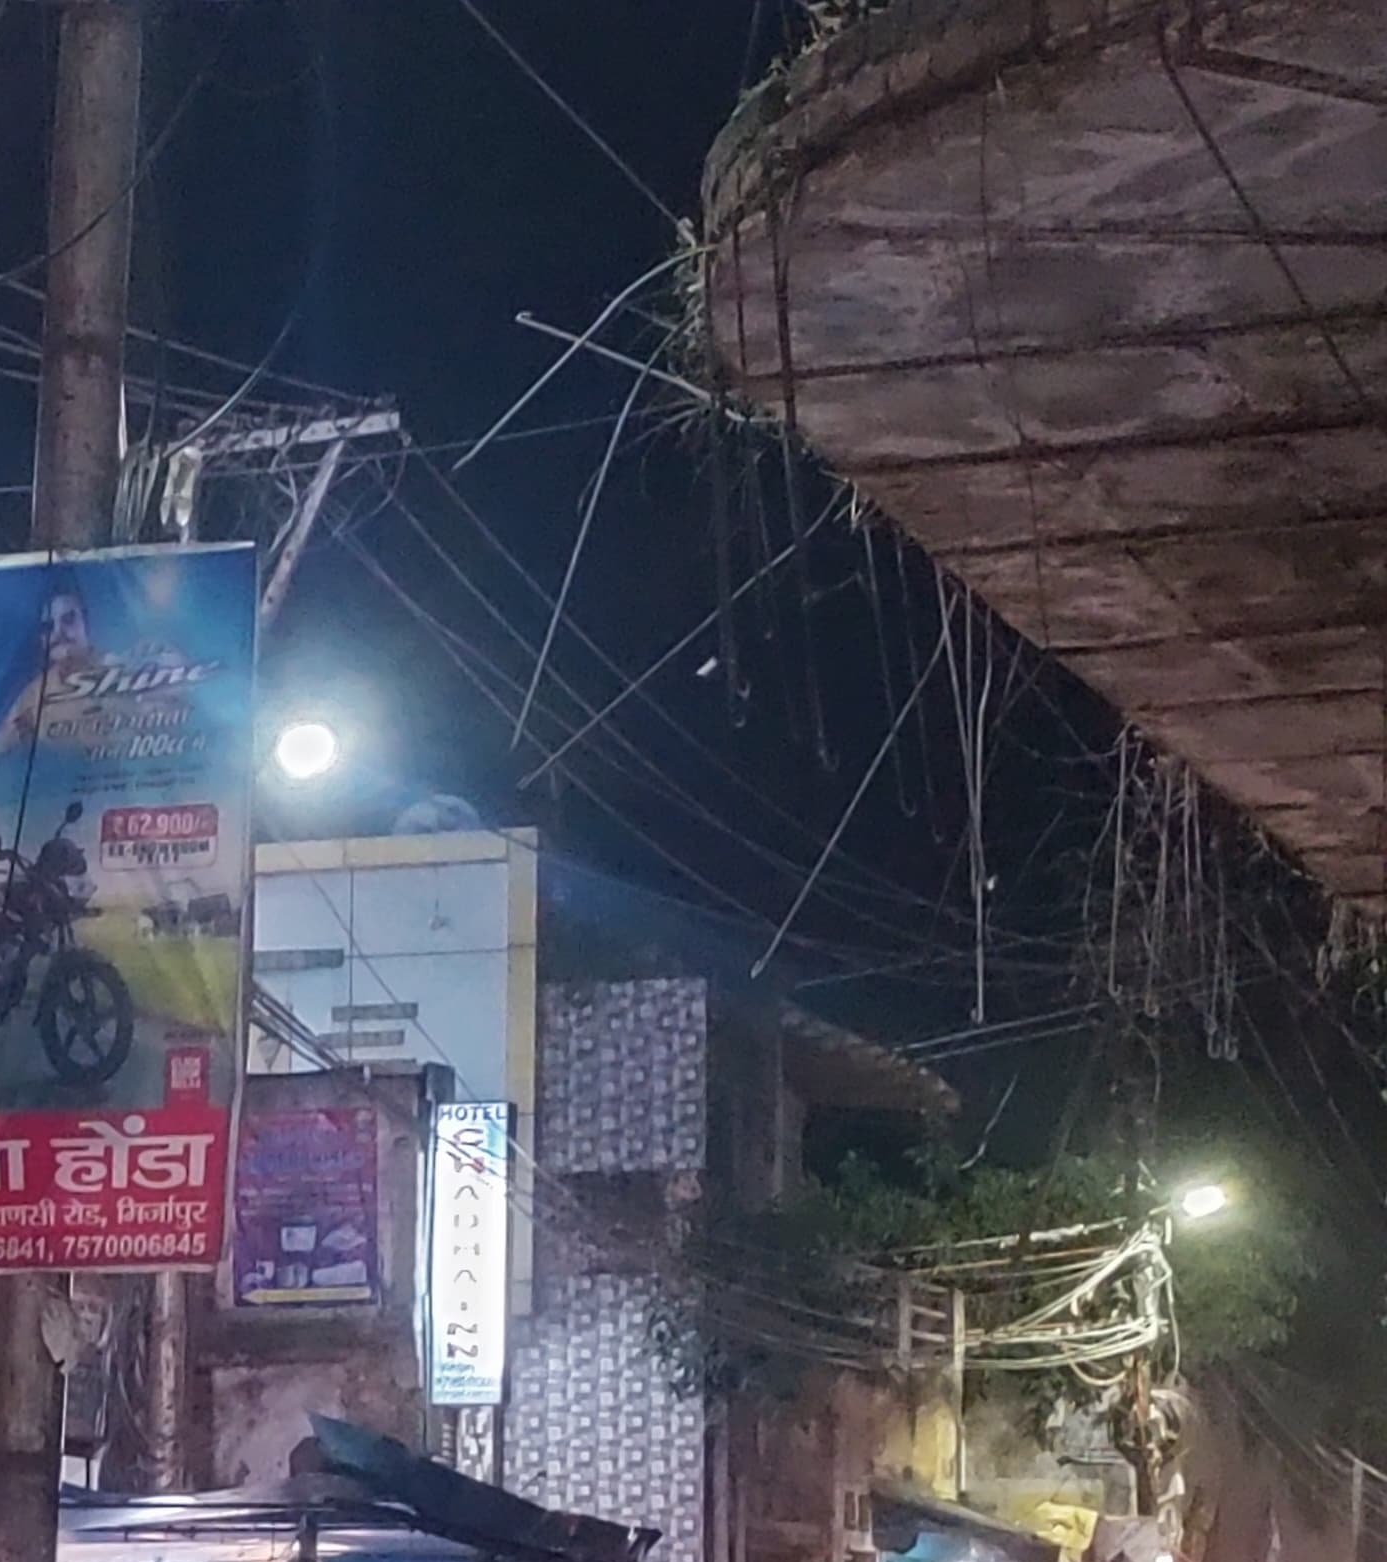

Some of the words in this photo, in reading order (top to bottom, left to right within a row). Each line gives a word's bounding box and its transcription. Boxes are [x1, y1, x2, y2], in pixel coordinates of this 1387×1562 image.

[438, 1104, 507, 1122] HOTEL
[49, 1115, 215, 1192] होंडा
[62, 1233, 206, 1259] 7570006845
